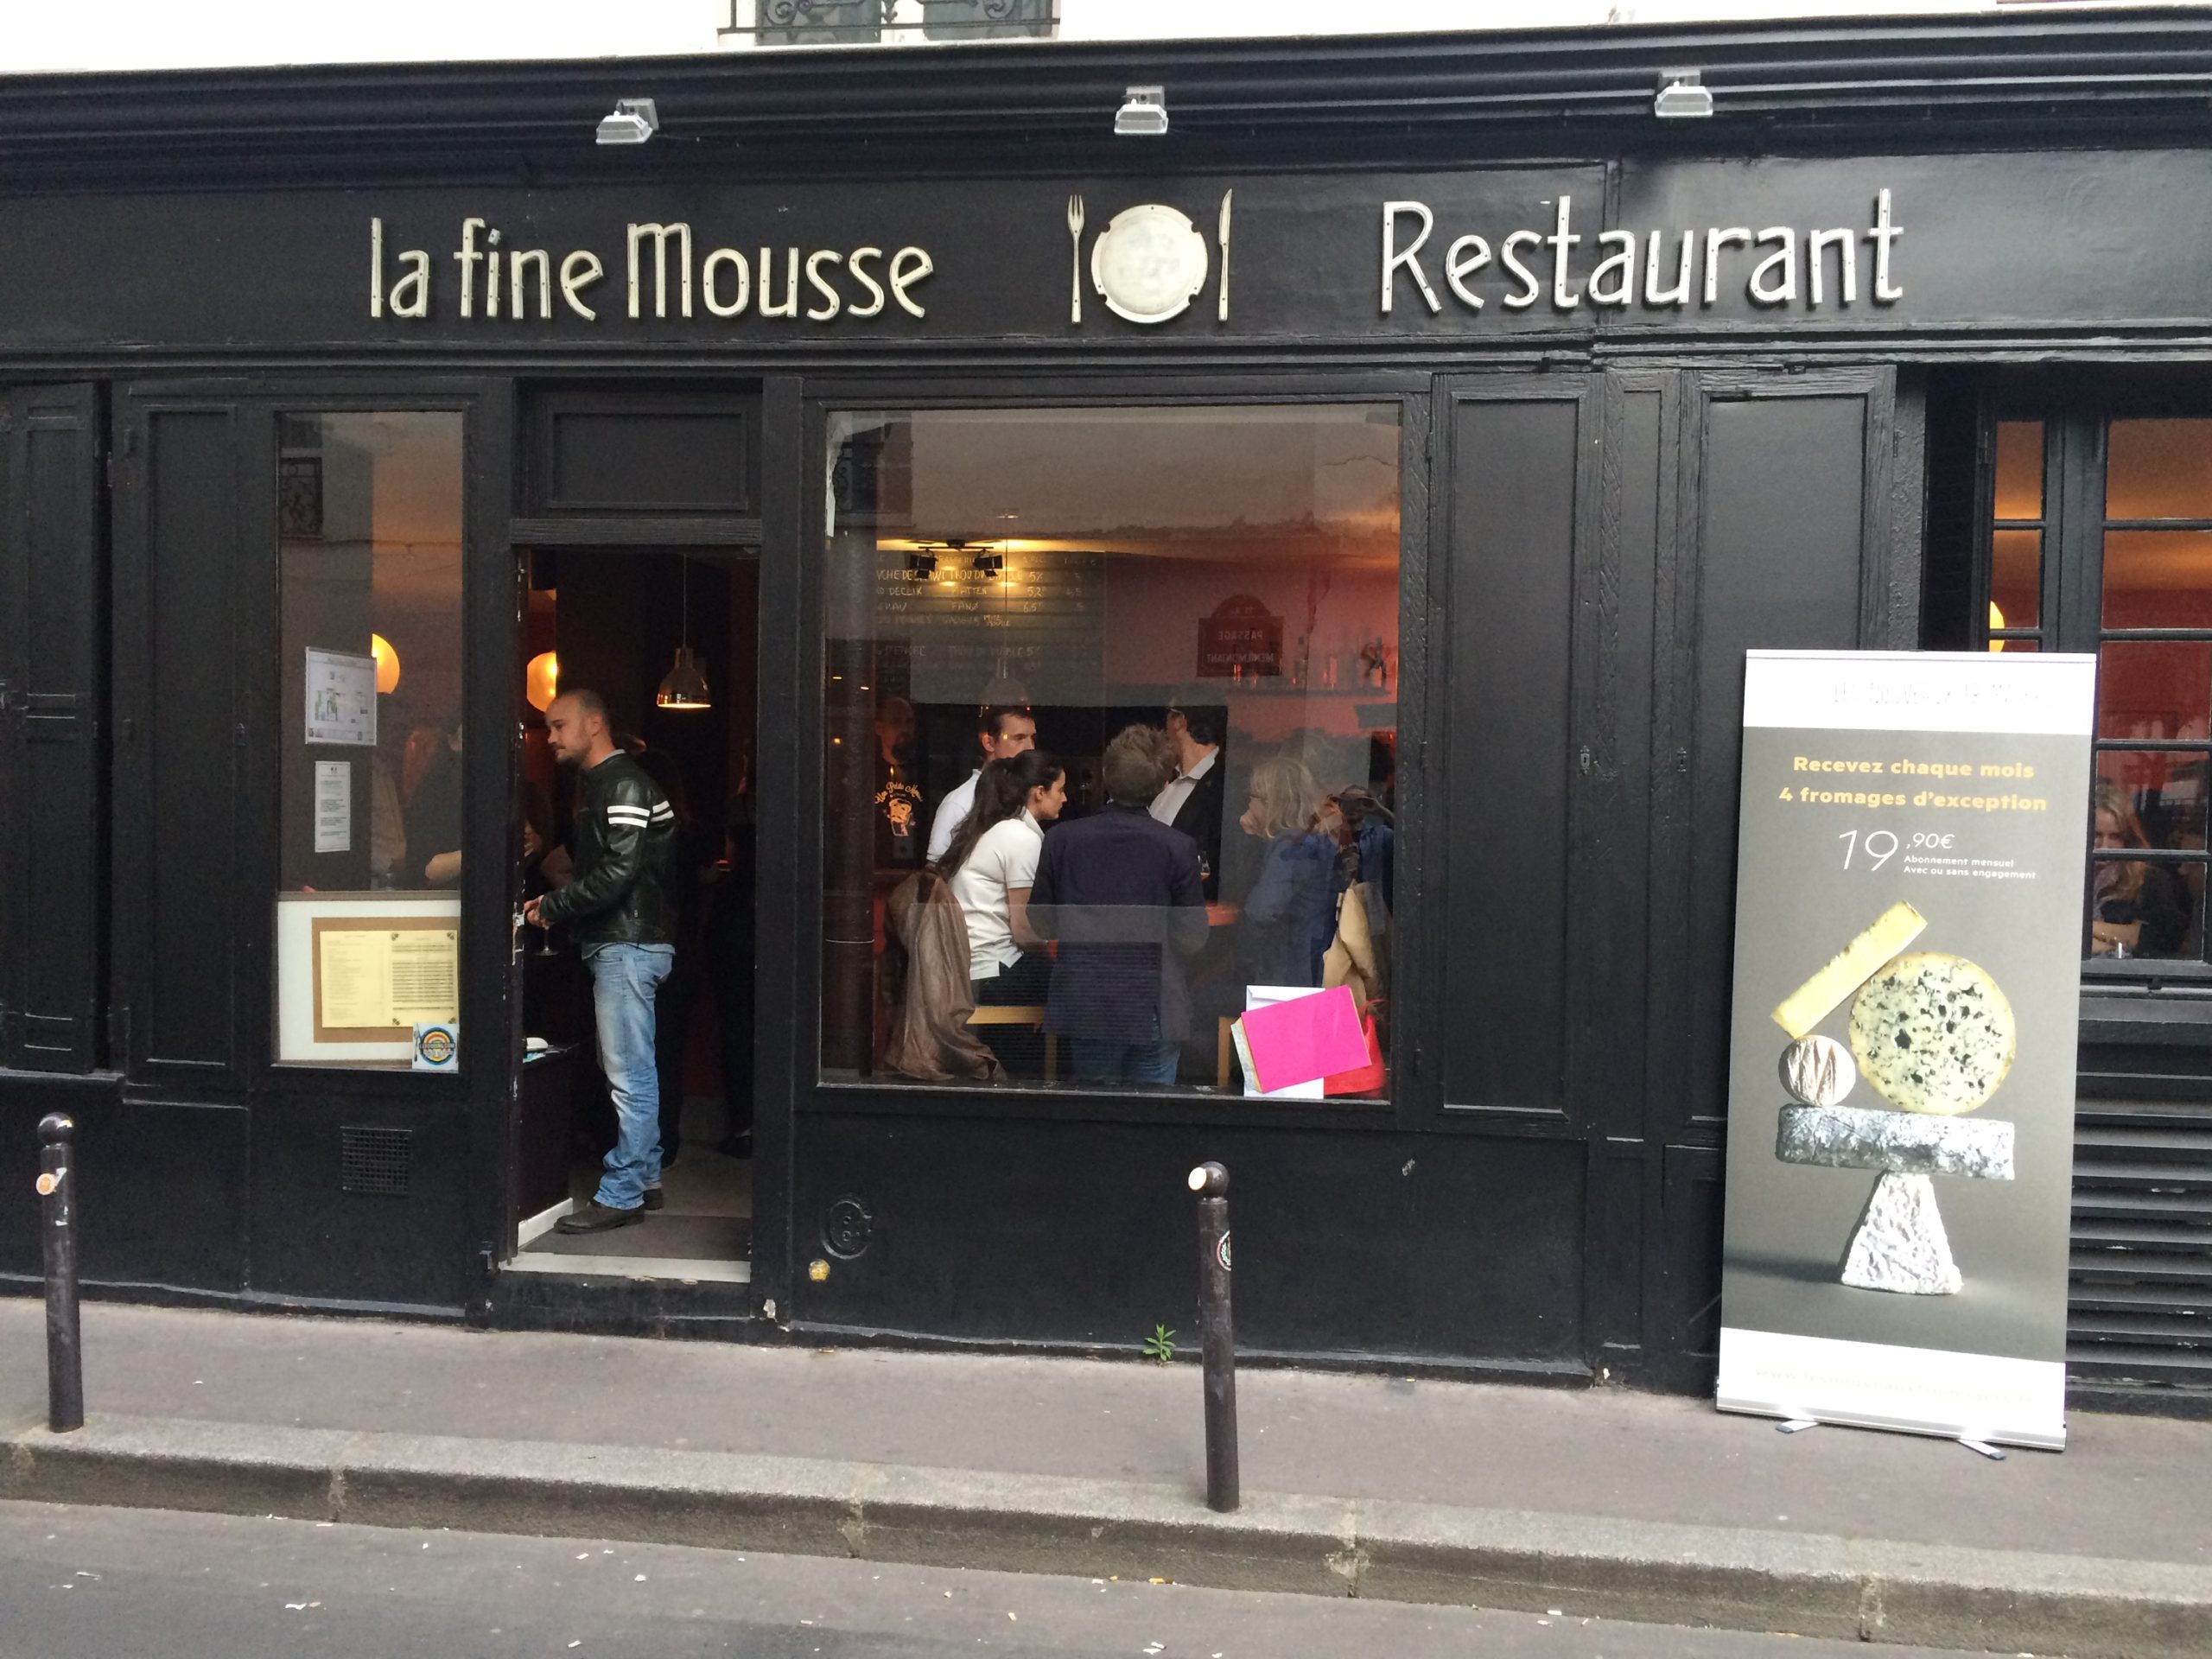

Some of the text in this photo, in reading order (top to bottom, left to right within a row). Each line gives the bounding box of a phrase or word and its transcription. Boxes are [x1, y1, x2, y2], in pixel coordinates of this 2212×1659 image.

[1382, 188, 1904, 313] Restaurant
[371, 217, 935, 321] la fine Mousse
[1793, 756, 2035, 779] Recevez chaque mois
[1778, 786, 2047, 812] 4 fromages d'exception
[1903, 866, 1928, 874] Avec
[1972, 869, 2037, 880] engagement
[1904, 855, 2014, 868] Abonnement mensuel
